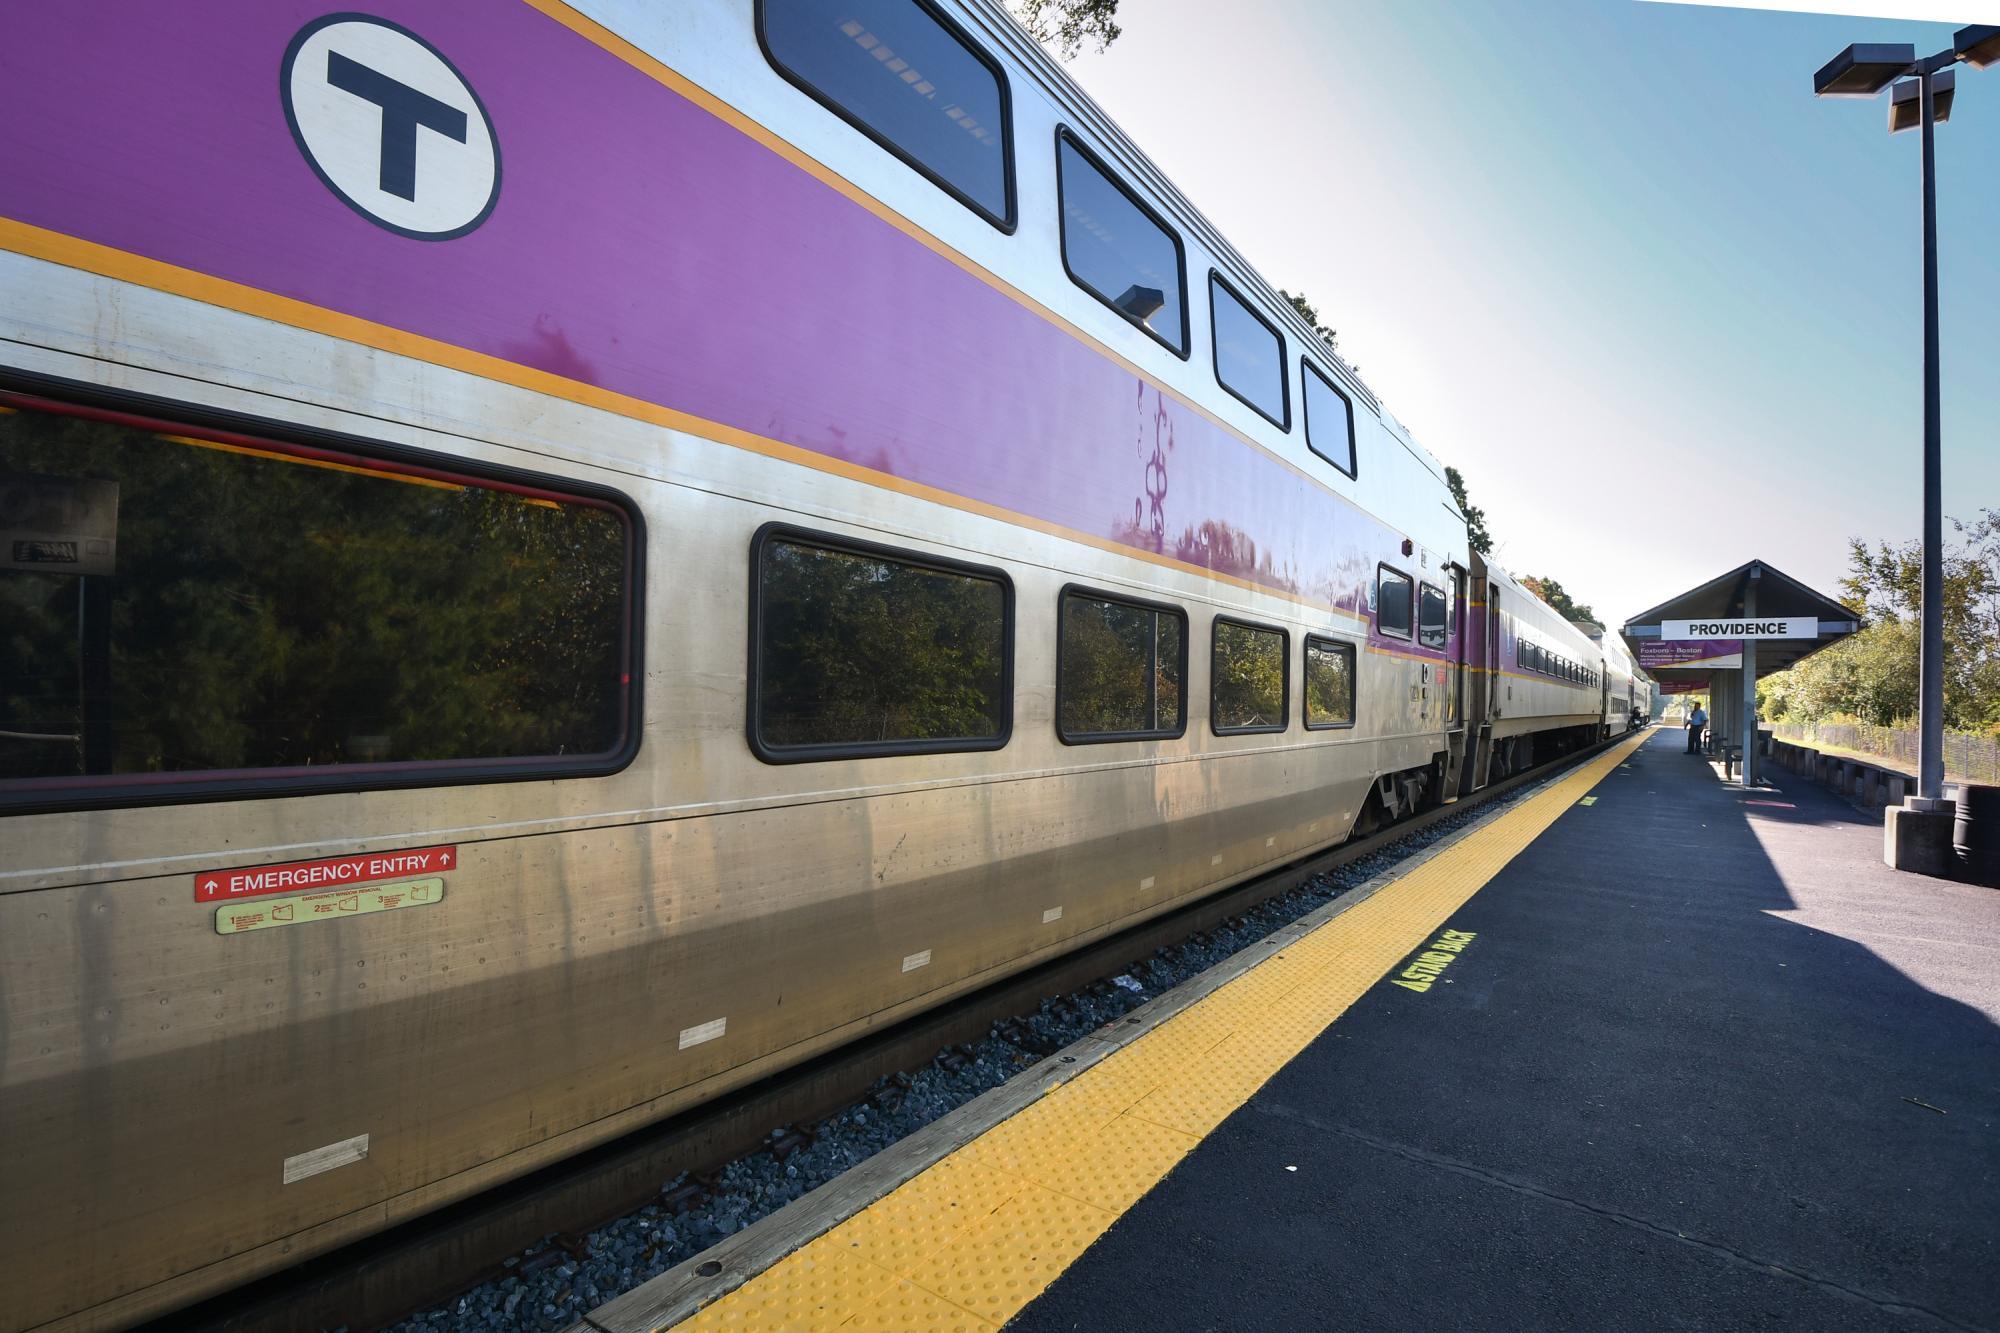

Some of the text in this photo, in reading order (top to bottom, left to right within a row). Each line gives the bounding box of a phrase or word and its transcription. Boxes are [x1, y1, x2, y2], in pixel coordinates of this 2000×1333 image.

[326, 49, 468, 203] T
[1689, 622, 1787, 636] PROVIDENCE
[230, 854, 430, 892] EMERGENCY ENTRY
[378, 895, 383, 903] 3
[230, 916, 235, 924] 1
[1402, 929, 1477, 982] STAND BACK
